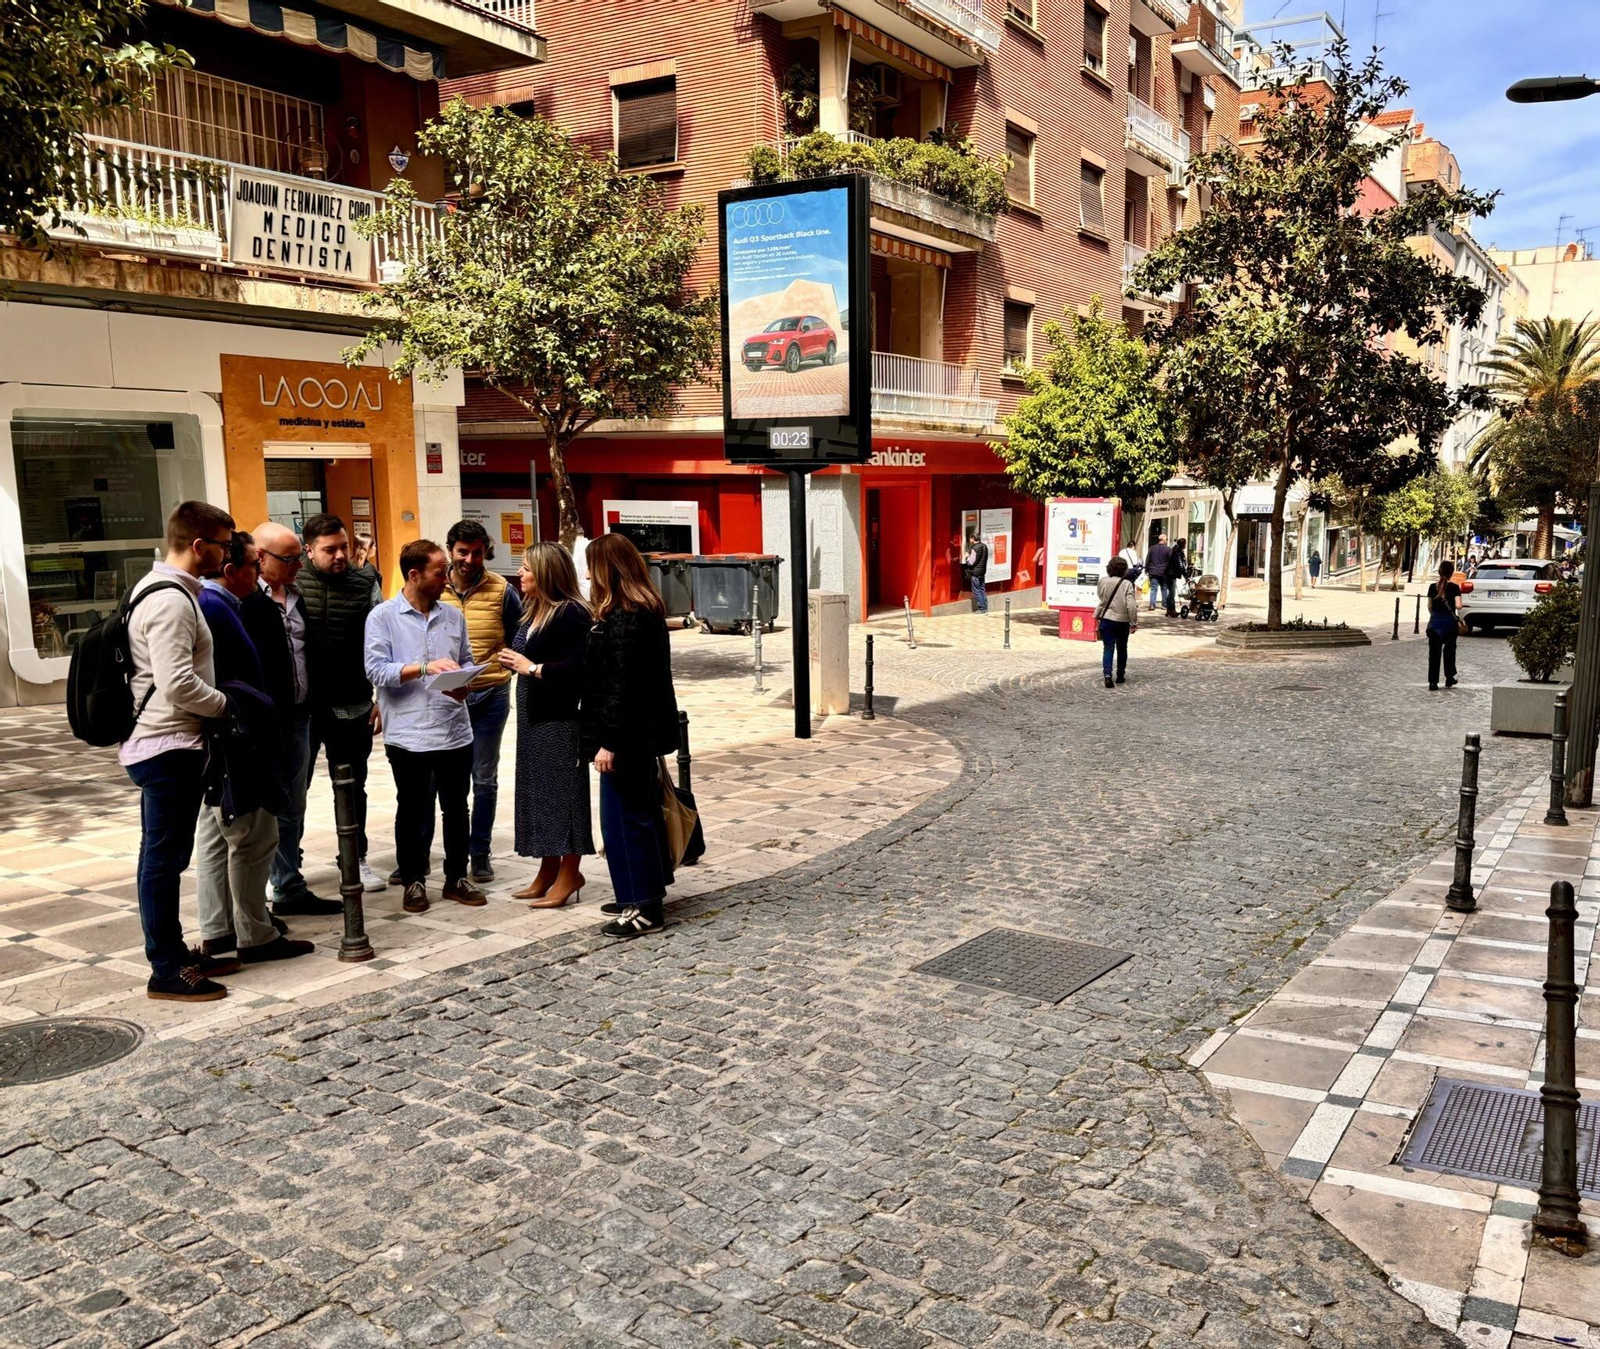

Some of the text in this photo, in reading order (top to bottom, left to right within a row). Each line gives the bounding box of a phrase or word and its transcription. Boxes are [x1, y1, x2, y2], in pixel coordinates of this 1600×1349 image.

[236, 179, 278, 208] JOAQUIN
[284, 188, 342, 220] FERNANDEZ
[263, 211, 346, 244] MEDICO
[749, 235, 759, 243] Q3
[761, 231, 794, 242] Sportback
[795, 229, 815, 238] Black
[252, 236, 352, 272] DENTISTA
[279, 417, 365, 429] medicina y estética
[772, 432, 808, 446] 00:23
[866, 446, 926, 467] ankinter.
[1168, 497, 1186, 511] STUDIO
